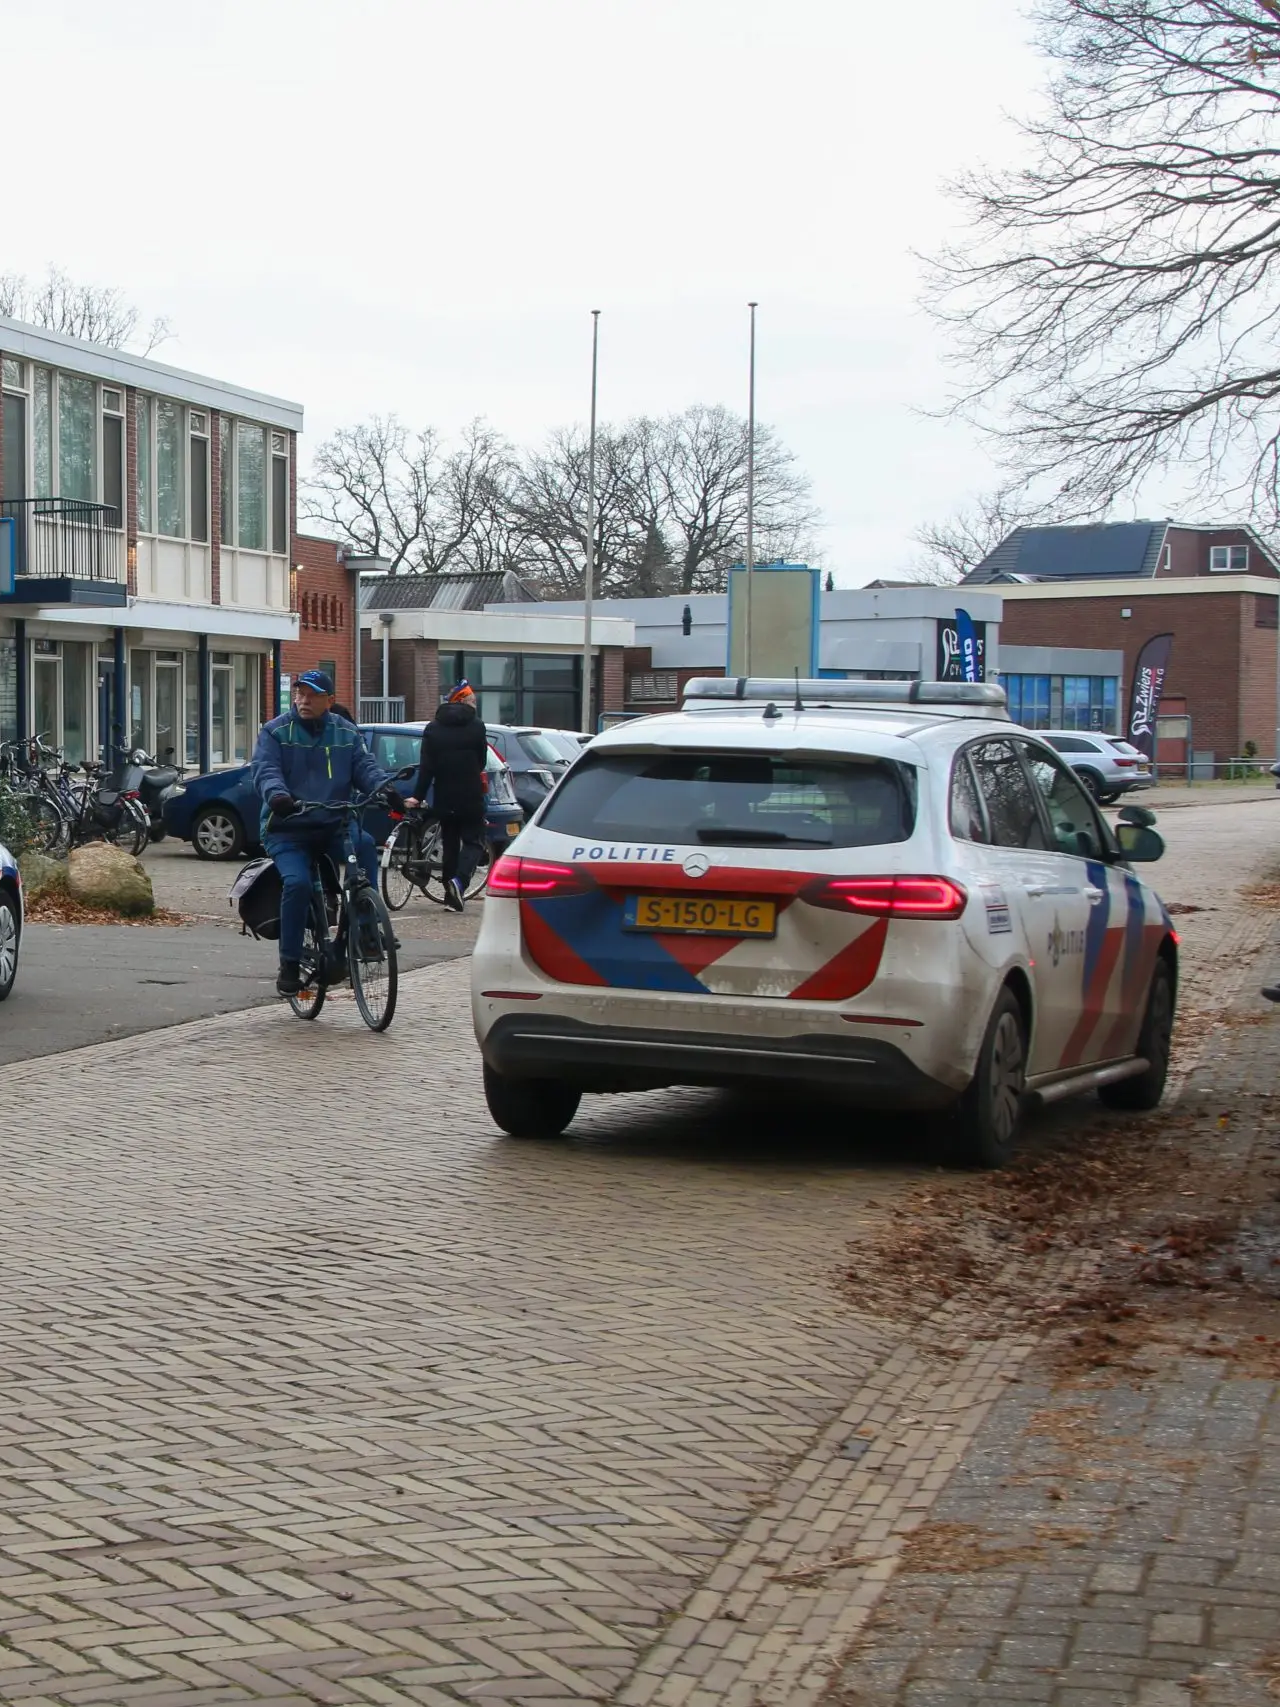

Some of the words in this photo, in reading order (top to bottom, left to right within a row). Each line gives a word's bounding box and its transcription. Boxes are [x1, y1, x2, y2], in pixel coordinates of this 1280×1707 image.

[1136, 667, 1152, 707] Zwiers
[572, 846, 676, 862] POLITIE
[646, 900, 761, 928] S-150-LG
